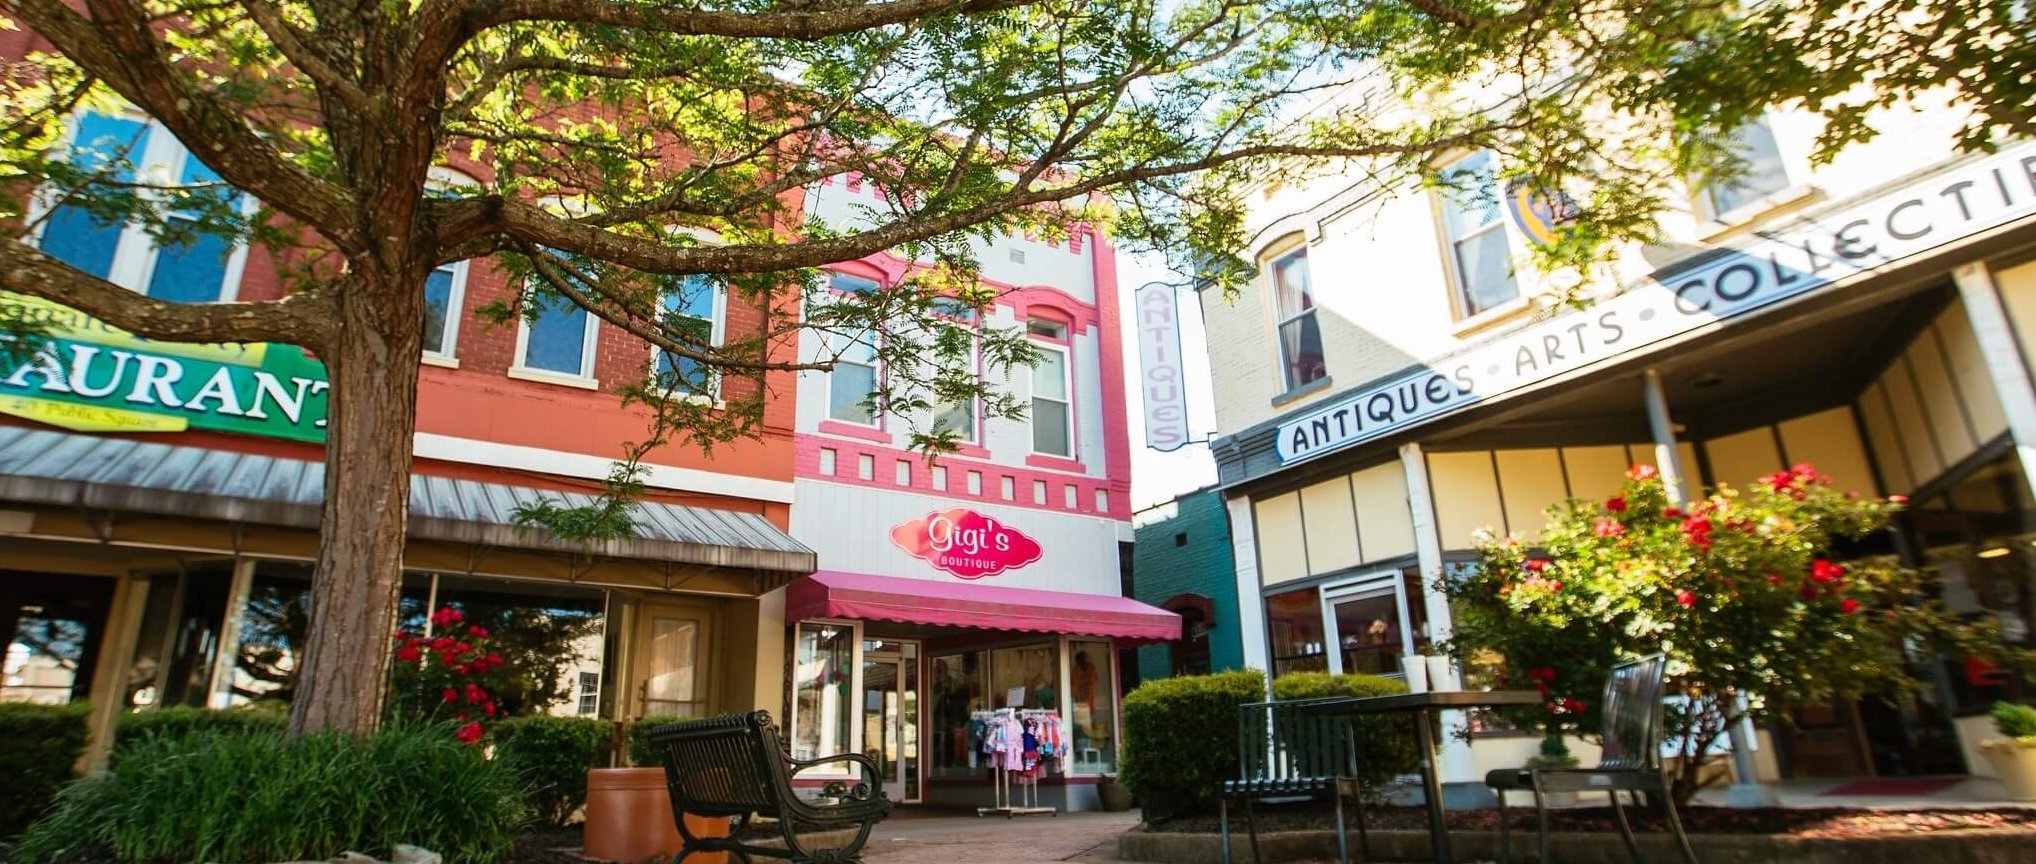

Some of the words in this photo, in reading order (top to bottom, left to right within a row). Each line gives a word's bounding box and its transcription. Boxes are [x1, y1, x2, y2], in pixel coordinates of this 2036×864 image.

[0, 334, 330, 427] AURAN
[1143, 290, 1181, 443] ANTIQUES
[1292, 365, 1475, 454] ANTIQUES
[1515, 311, 1624, 376] ARTS
[928, 516, 1010, 555] Gigi's
[941, 556, 997, 570] BOUTIQUE
